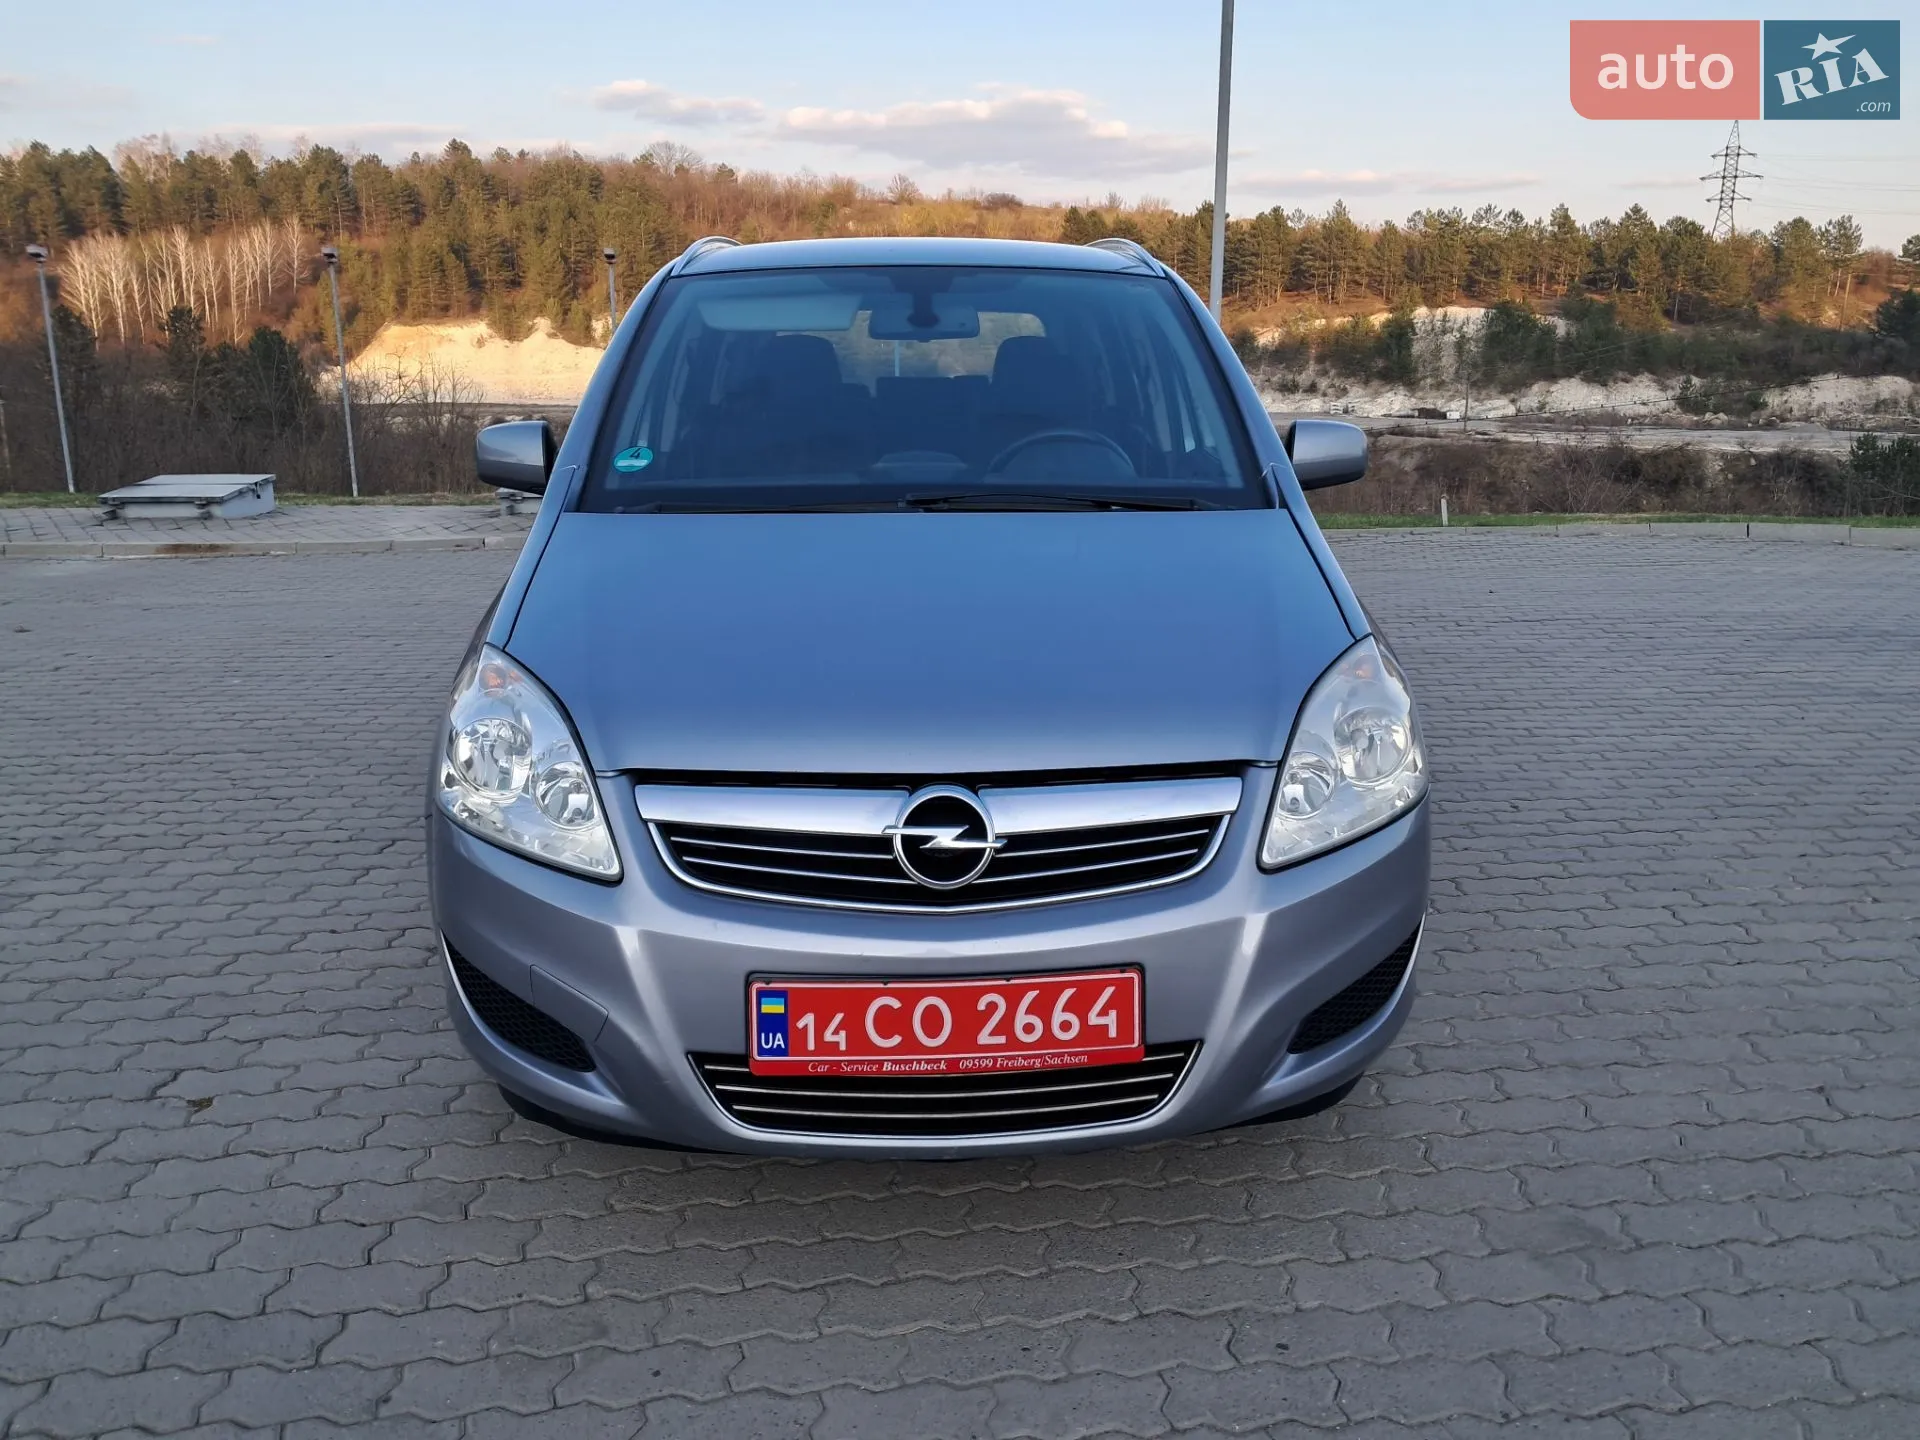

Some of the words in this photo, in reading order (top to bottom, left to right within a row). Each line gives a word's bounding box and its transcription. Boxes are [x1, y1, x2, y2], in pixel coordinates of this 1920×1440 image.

[795, 1012, 847, 1051] 14
[864, 995, 953, 1048] CO
[976, 985, 1118, 1046] 2664
[761, 1031, 785, 1050] UA
[808, 1061, 830, 1072] Car
[840, 1060, 879, 1072] Service
[882, 1059, 947, 1072] Buschbeck
[959, 1057, 993, 1070] 09599
[996, 1053, 1088, 1068] Freiberg/Sachsen
